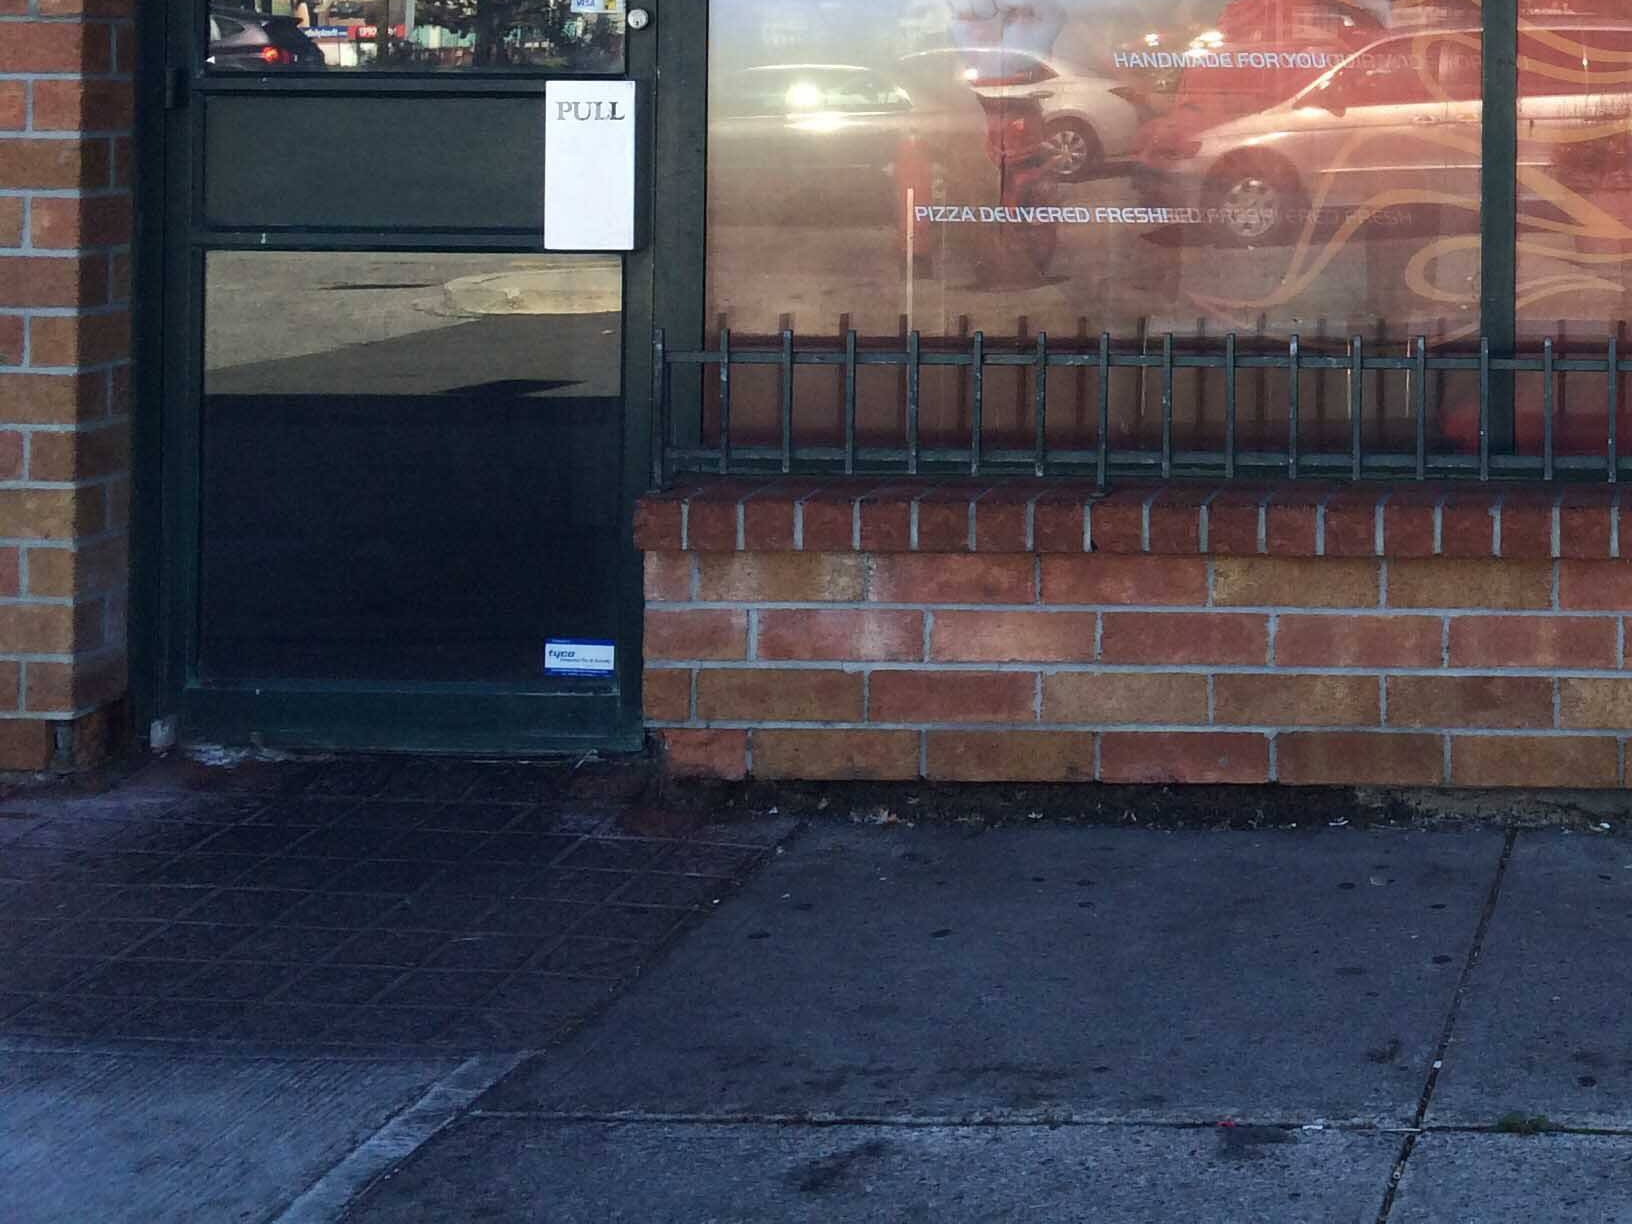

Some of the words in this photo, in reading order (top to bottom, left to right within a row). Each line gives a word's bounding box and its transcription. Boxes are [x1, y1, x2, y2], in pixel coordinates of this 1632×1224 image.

[1113, 52, 1234, 69] HANDMADE
[1238, 52, 1282, 69] FOR
[1285, 52, 1327, 69] YOU
[555, 100, 626, 121] PULL
[915, 206, 977, 223] PIZZA
[980, 206, 1090, 223] DELIVERED
[1094, 206, 1168, 224] FRESH!
[548, 649, 575, 659] tyco
